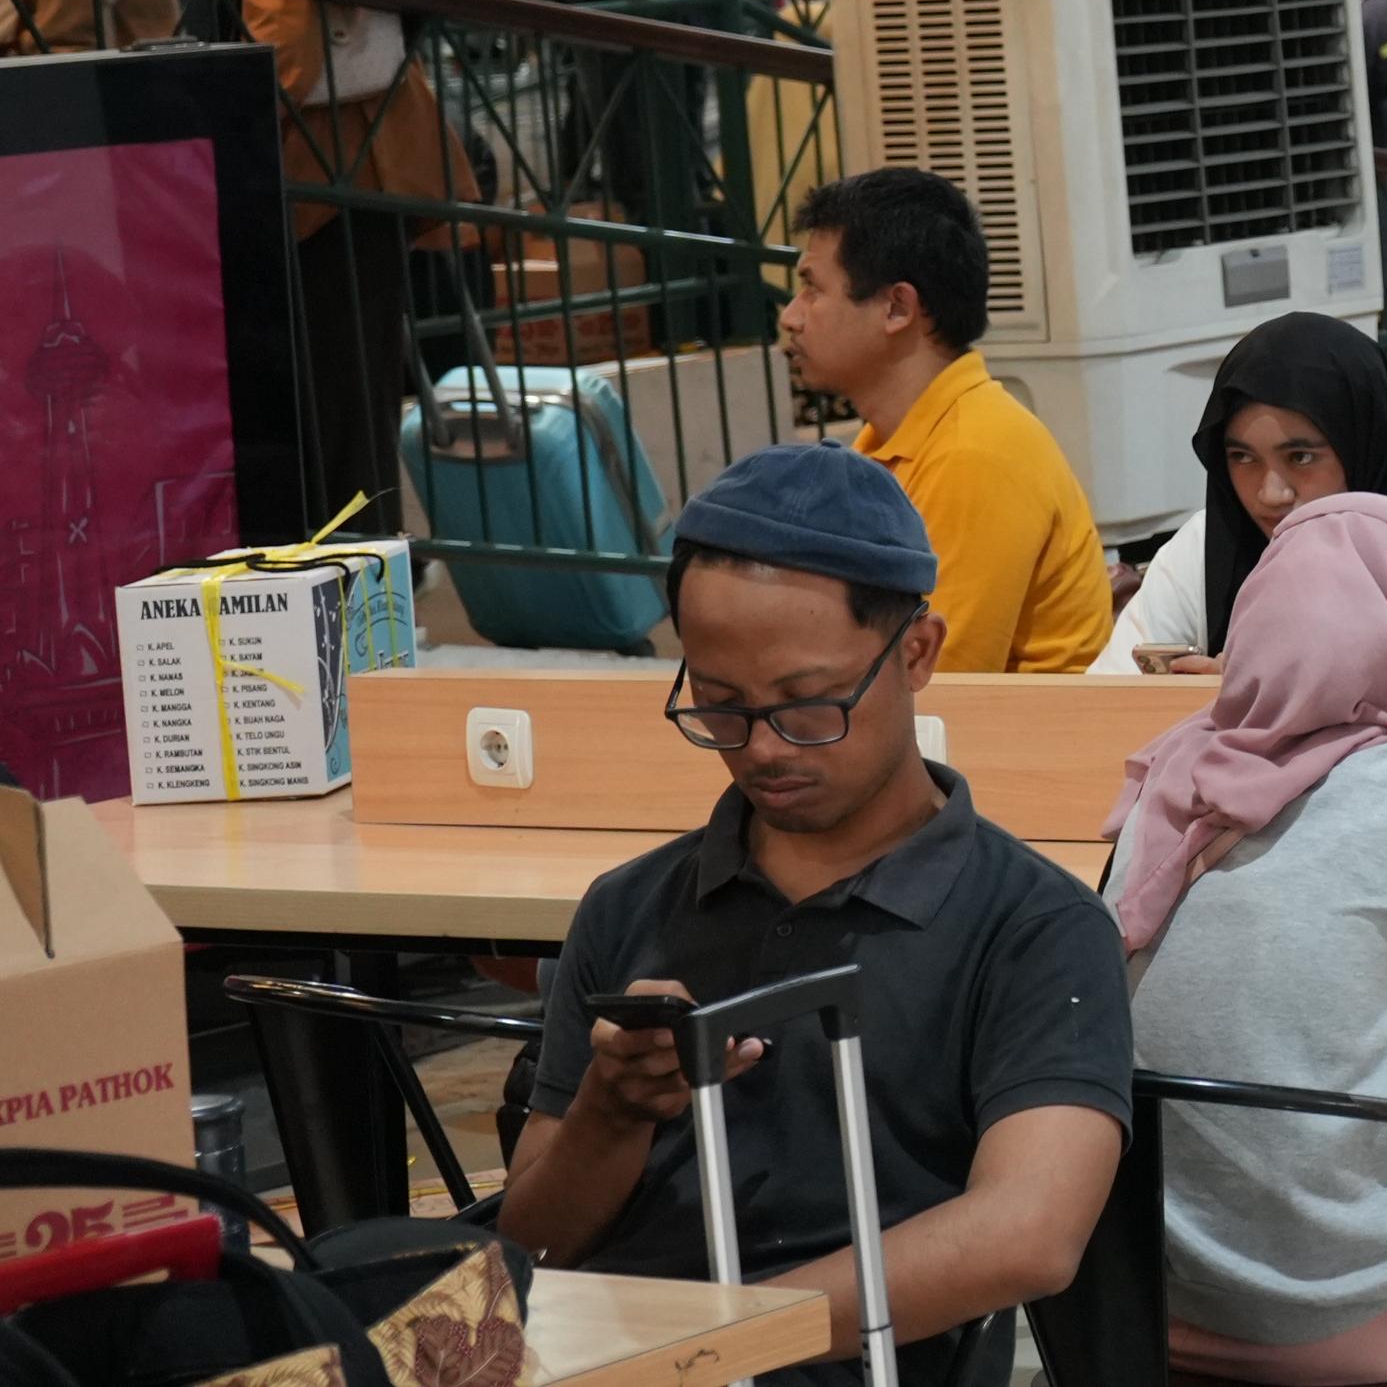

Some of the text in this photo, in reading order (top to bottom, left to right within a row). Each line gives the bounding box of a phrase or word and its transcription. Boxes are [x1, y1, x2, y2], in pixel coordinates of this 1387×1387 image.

[140, 592, 288, 621] ANEKA AMILAN
[161, 718, 192, 728] NANGKA
[58, 1062, 176, 1114] PATHOK
